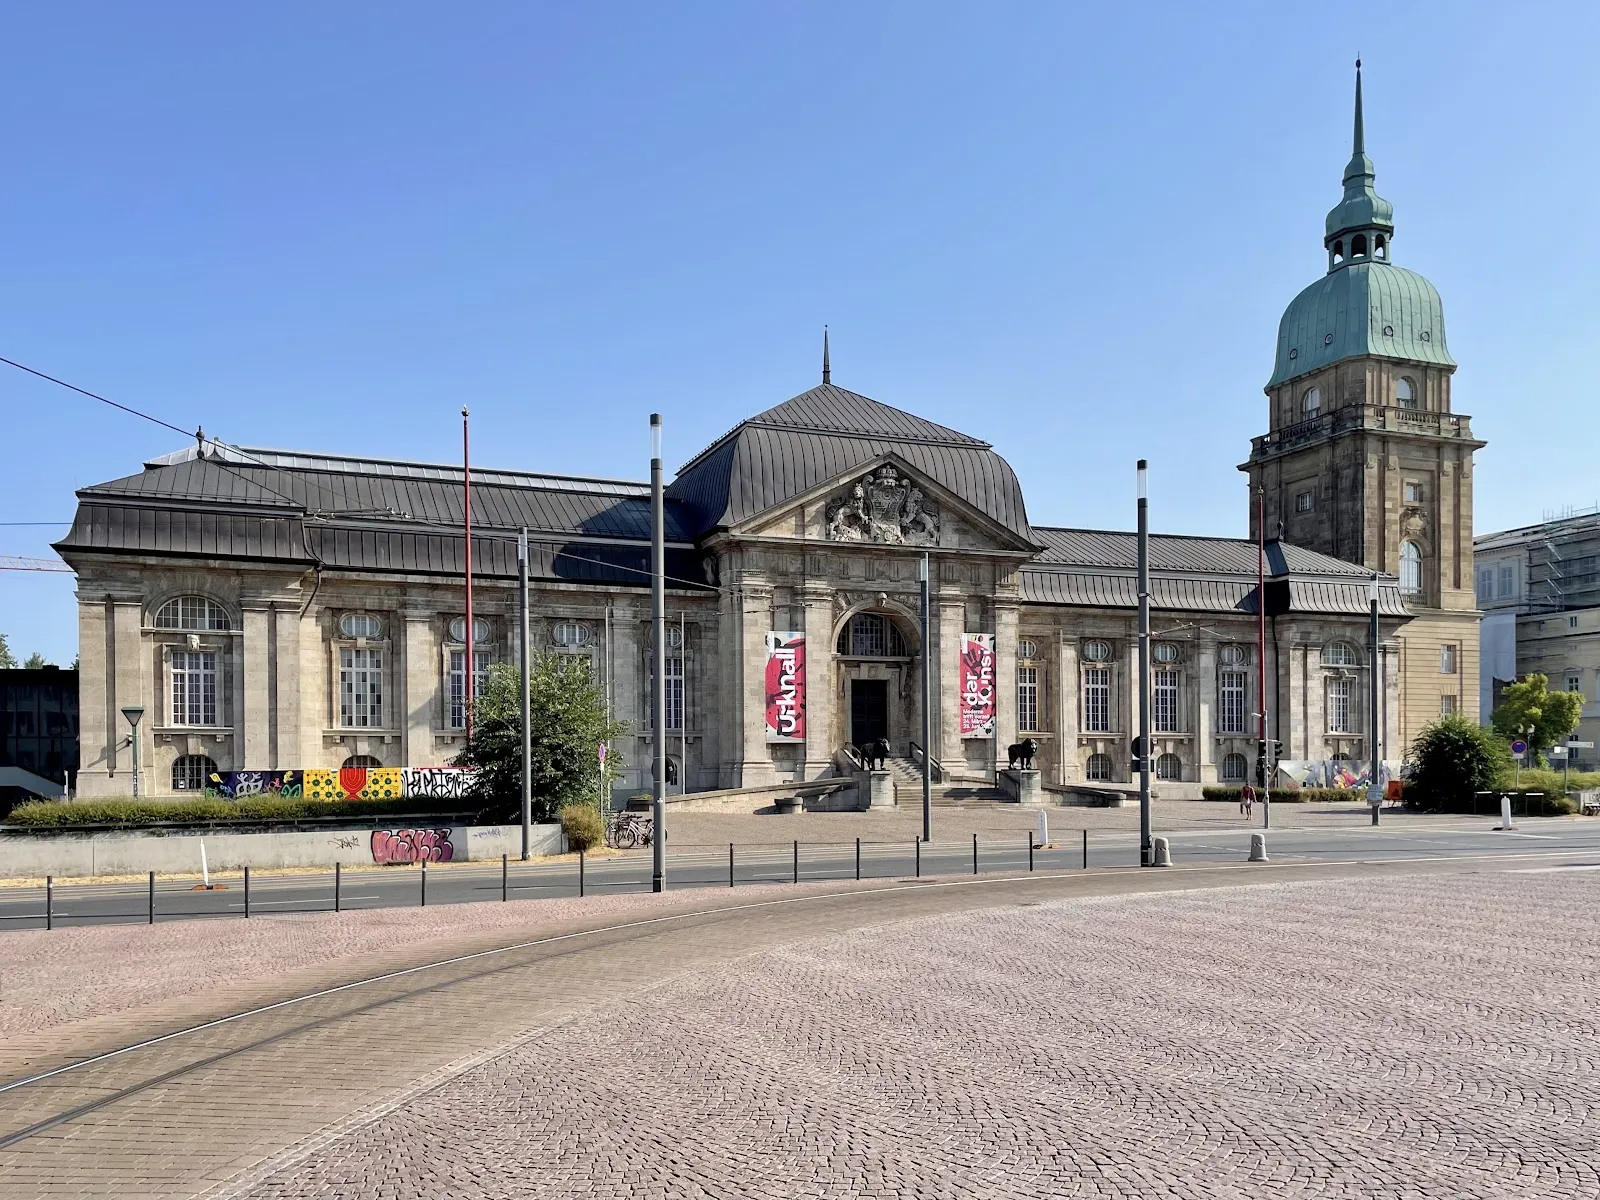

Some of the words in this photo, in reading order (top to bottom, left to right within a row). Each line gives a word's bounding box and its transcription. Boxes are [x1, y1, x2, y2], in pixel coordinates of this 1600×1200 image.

[776, 648, 796, 733] Urknall
[963, 672, 978, 705] der
[978, 648, 992, 705] Kunst
